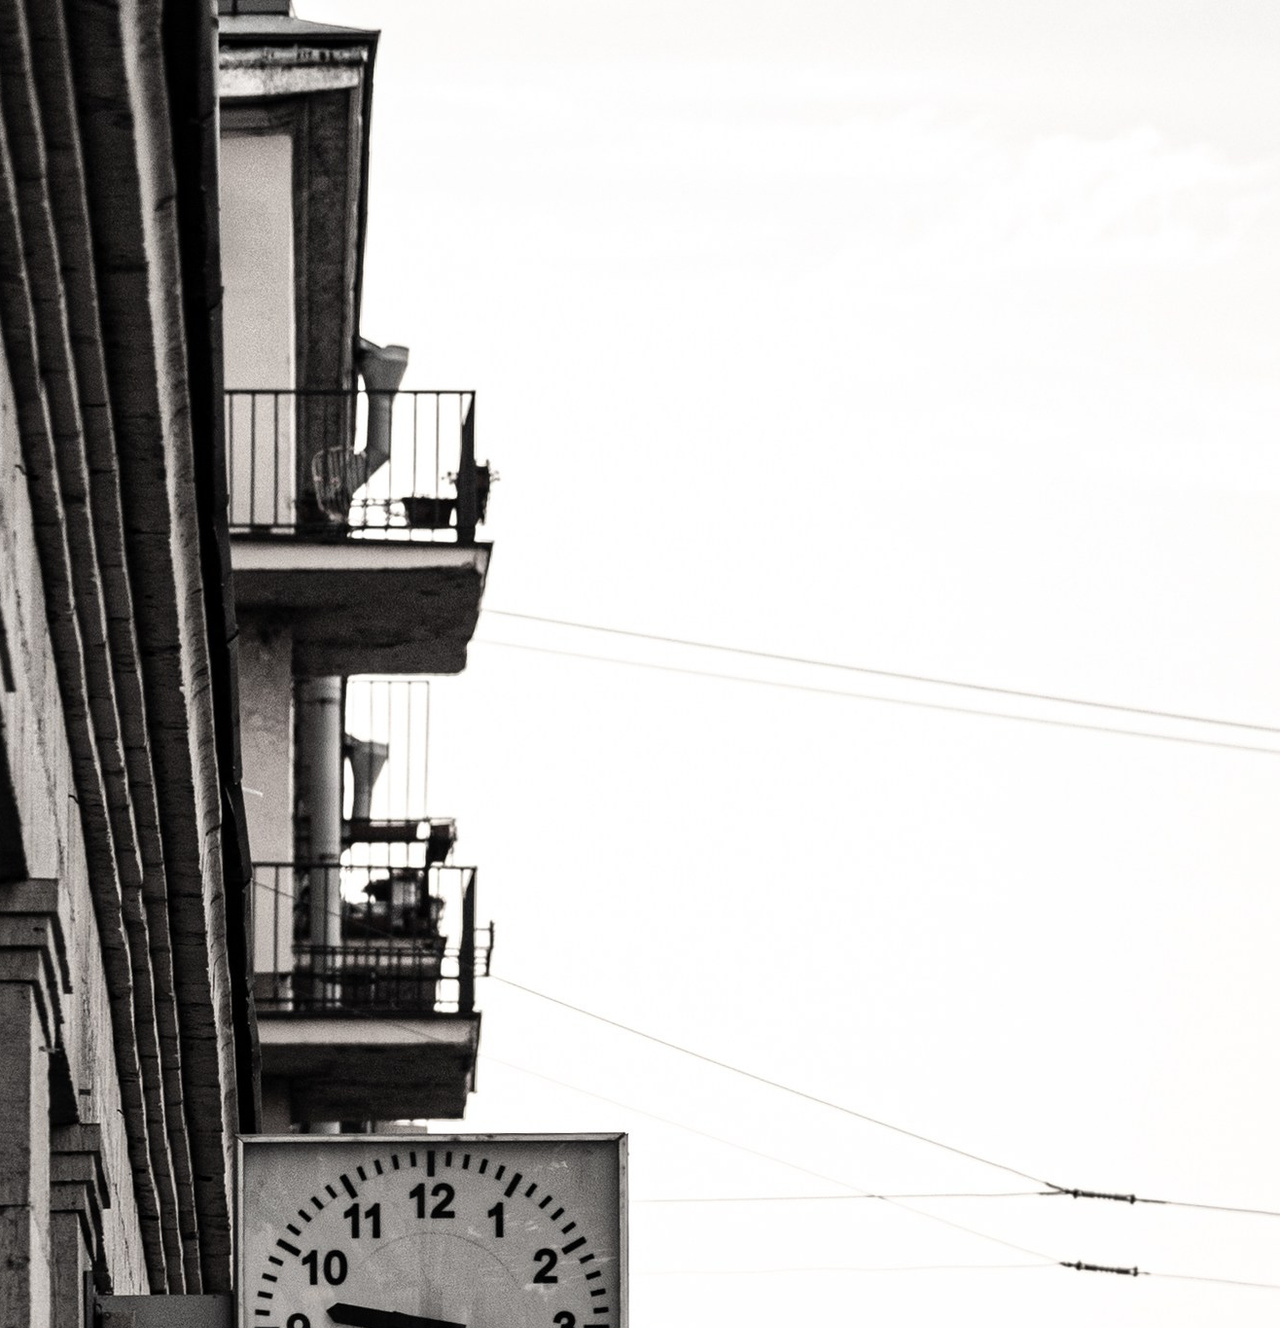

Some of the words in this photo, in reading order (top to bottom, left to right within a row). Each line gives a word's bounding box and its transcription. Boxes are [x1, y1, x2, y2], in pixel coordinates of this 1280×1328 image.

[408, 1182, 456, 1220] 12
[343, 1202, 381, 1239] 11
[487, 1201, 505, 1239] 1
[301, 1249, 348, 1286] 10
[532, 1247, 559, 1284] 2
